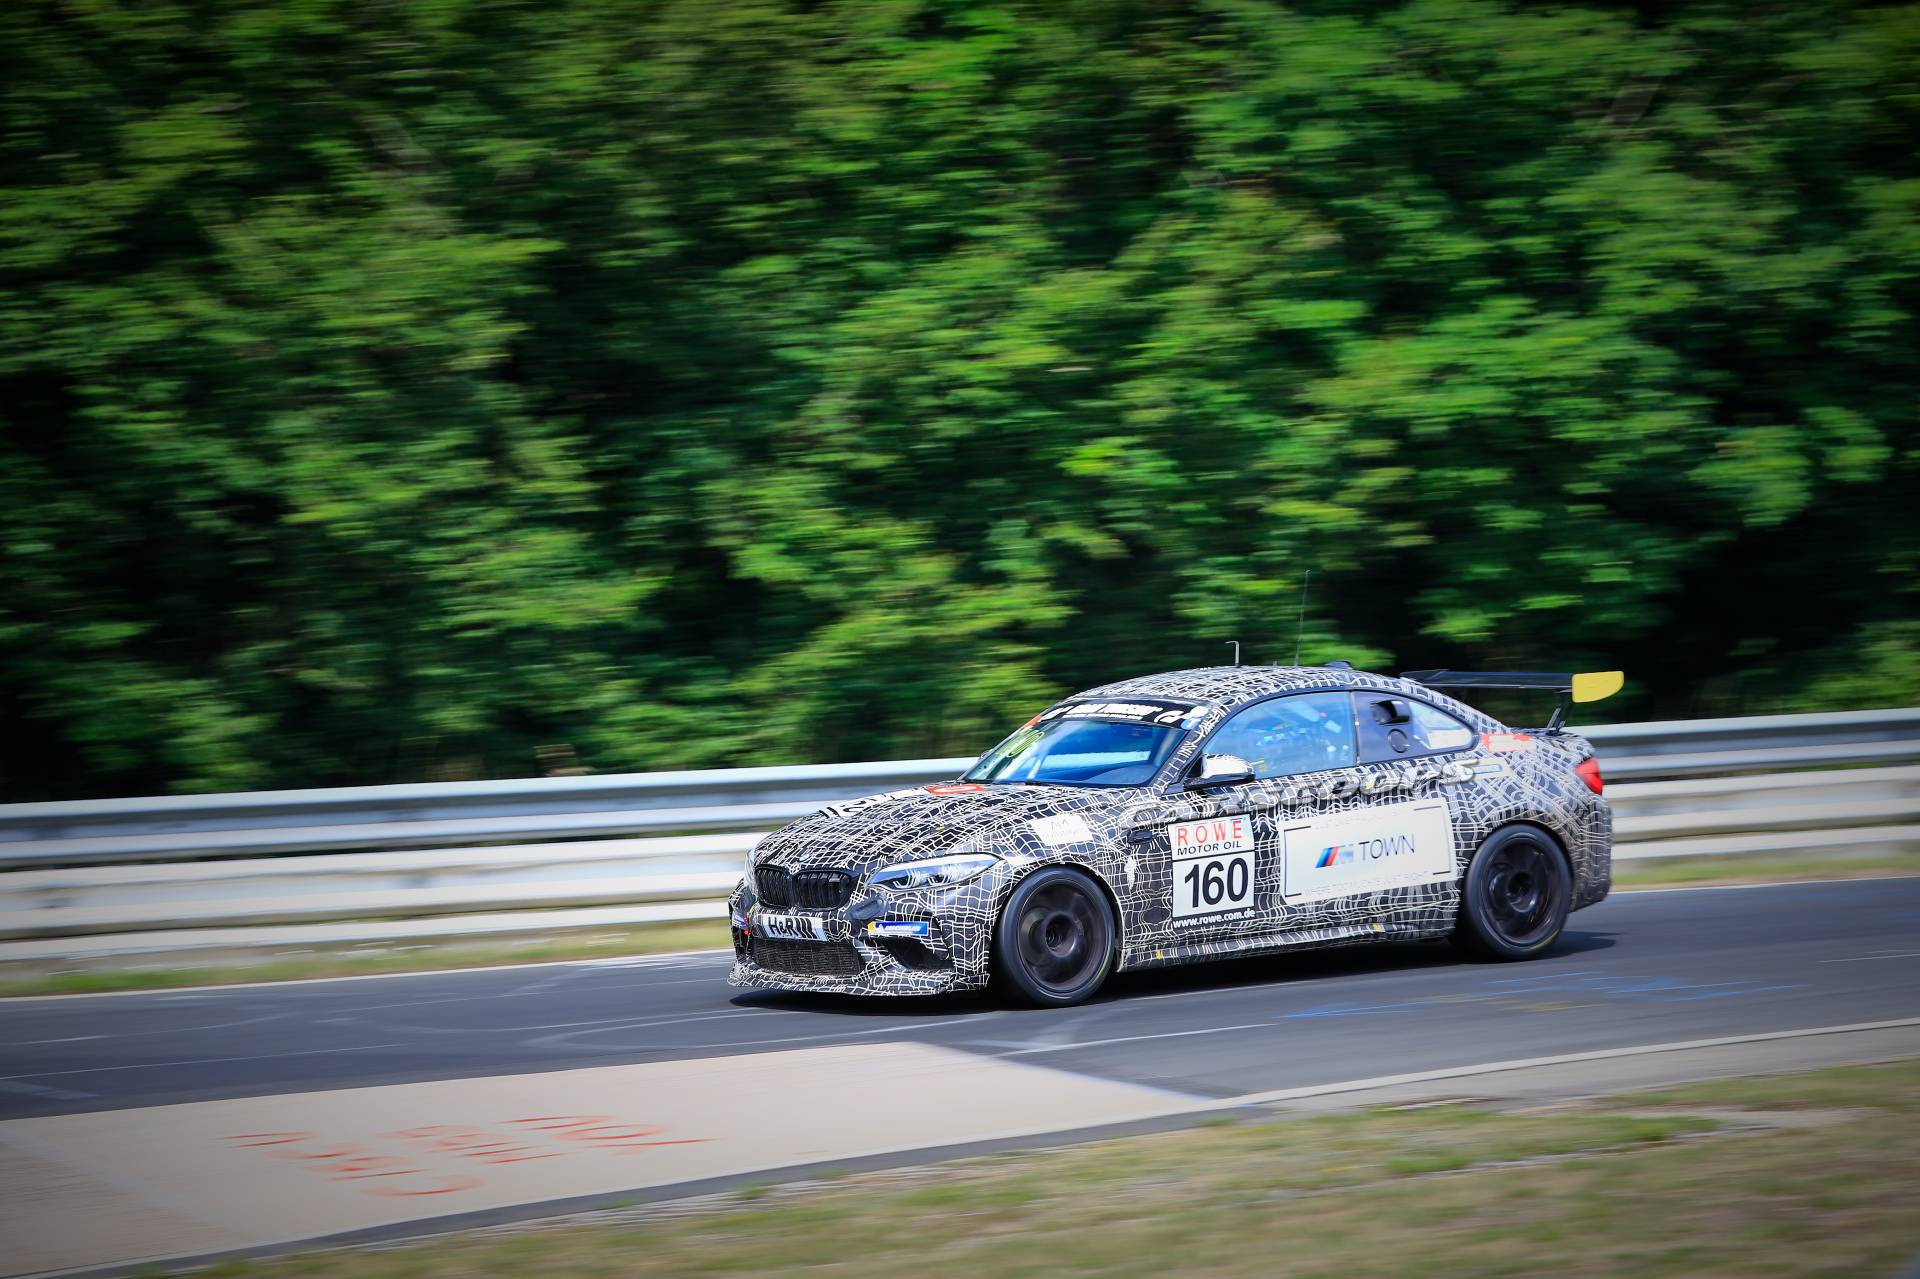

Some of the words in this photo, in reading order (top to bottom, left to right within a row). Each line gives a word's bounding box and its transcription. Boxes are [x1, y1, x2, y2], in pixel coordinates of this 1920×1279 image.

[1177, 820, 1242, 847] ROWE
[1177, 843, 1220, 855] MOTOR
[1223, 840, 1242, 850] OIL
[1358, 832, 1415, 861] TOWN
[1184, 857, 1249, 908] 160
[768, 916, 799, 936] H&R
[1173, 908, 1256, 928] www.rowe.com.de
